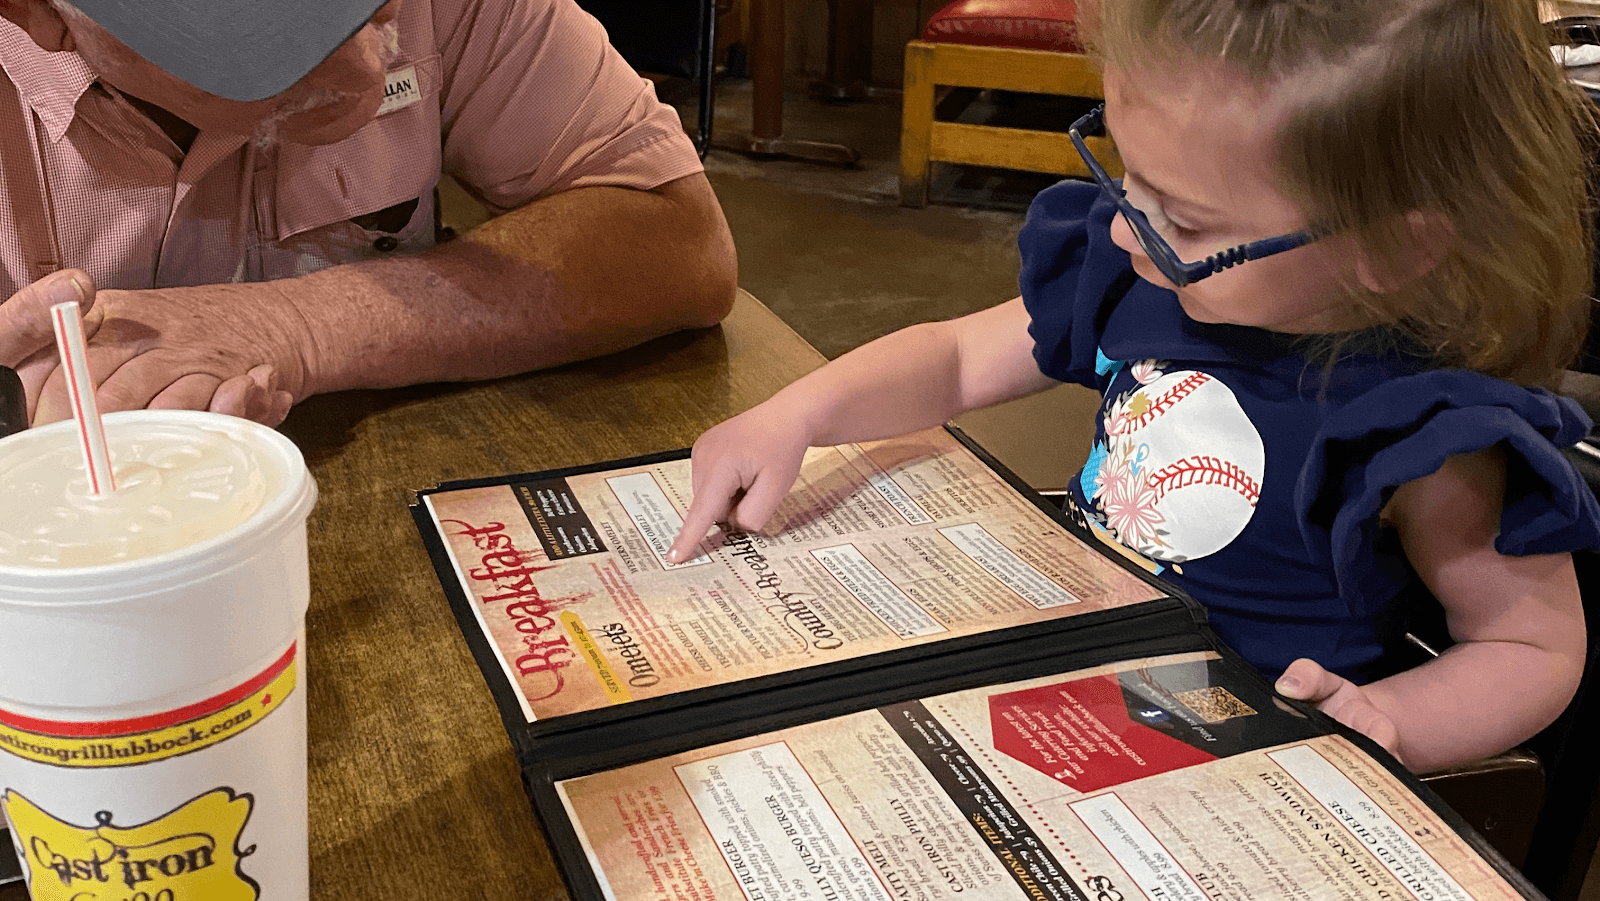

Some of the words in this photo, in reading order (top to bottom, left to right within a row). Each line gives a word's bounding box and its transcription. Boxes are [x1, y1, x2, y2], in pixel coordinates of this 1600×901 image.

[848, 493, 870, 510] STACK
[877, 485, 899, 501] TOAST
[864, 510, 887, 527] SHORT
[893, 501, 920, 522] FRENCH
[914, 495, 944, 518] OATMEAL
[600, 521, 621, 544] OMELET
[634, 513, 655, 536] OMELET
[615, 544, 639, 572] WESTERN
[820, 556, 840, 570] EGGS
[972, 554, 1015, 582] BREAKFAST
[840, 575, 863, 591] STEAK
[907, 588, 928, 602] EGGS
[1010, 583, 1029, 593] EGG
[441, 514, 582, 701] Breakfast
[858, 592, 881, 608] FRIED
[1024, 593, 1046, 606] TWO
[874, 607, 906, 631] CHICKEN
[929, 607, 953, 623] STEAK
[592, 621, 662, 689] Omelets
[1002, 711, 1014, 720] on
[1011, 704, 1041, 731] Services
[1031, 710, 1056, 728] Truck
[1008, 720, 1032, 739] latest
[1049, 728, 1074, 746] Food
[1086, 729, 1103, 741] our
[1190, 725, 1217, 741] Find
[886, 743, 902, 754] roll
[1029, 739, 1044, 750] the
[1037, 730, 1071, 760] Catering
[1040, 750, 1057, 763] For
[1068, 746, 1089, 760] and
[1097, 741, 1119, 756] visit
[706, 764, 722, 780] BBQ
[775, 765, 802, 792] peppers
[872, 760, 889, 773] bell
[945, 763, 968, 785] Cheese
[1067, 760, 1085, 773] our
[762, 770, 783, 790] sliced
[882, 773, 911, 797] grilled
[895, 772, 922, 797] topped
[922, 785, 934, 794] on
[962, 765, 997, 802] Mushrooms
[1229, 778, 1256, 802] lettuce
[1352, 770, 1377, 788] Grill
[700, 778, 723, 805] smoked
[723, 788, 746, 812] pickles
[790, 793, 808, 808] bell
[1187, 789, 1213, 814] crispy
[1258, 772, 1322, 830] SANDWICH
[1288, 787, 1312, 807] onion
[1376, 789, 1397, 805] Iron
[763, 794, 797, 836] BURGER
[852, 805, 878, 830] melted
[885, 796, 922, 834] PHILLY
[927, 796, 954, 820] served
[991, 803, 1018, 827] Grilled
[1307, 808, 1325, 820] red
[1395, 807, 1421, 826] Cast
[740, 813, 760, 842] onions,
[787, 809, 812, 835] topped
[807, 808, 840, 855] mushrooms,
[915, 816, 938, 837] steak
[919, 799, 957, 842] mushrooms
[969, 811, 1003, 845] ITEMS:
[981, 806, 1014, 841] Jalapeños
[1100, 809, 1125, 833] chicken
[1150, 801, 1192, 843] guacamole,
[1208, 815, 1233, 835] thick
[1258, 803, 1308, 853] mayonnaise,
[1327, 800, 1378, 844] CHEESE
[1371, 826, 1385, 837] an
[727, 825, 751, 852] topped
[890, 833, 908, 852] 8.29
[951, 822, 975, 846] cheese
[1331, 828, 1362, 856] tomato
[1383, 825, 1419, 854] pickles
[790, 837, 822, 874] QUESO
[807, 835, 831, 858] patty
[862, 838, 890, 868] MELT
[880, 840, 904, 866] onions
[914, 835, 943, 862] IRON
[934, 837, 957, 862] Philly
[1189, 844, 1215, 871] cheese,
[1383, 838, 1423, 874] between
[31, 832, 117, 884] Cast
[119, 846, 215, 889] iron
[721, 839, 755, 884] BURGER
[746, 852, 769, 875] patty
[753, 843, 791, 893] caramelized
[838, 855, 862, 883] queso,
[966, 854, 990, 885] onions,
[972, 848, 994, 871] Swiss
[1032, 848, 1058, 876] Onions
[1136, 849, 1161, 872] apples
[1239, 844, 1271, 875] tomato
[1310, 855, 1340, 885] cheese,
[1319, 832, 1379, 886] CHICKEN
[935, 863, 965, 892] CAST
[949, 862, 978, 889] Sliced
[987, 870, 1003, 881] of
[1028, 862, 1049, 883] Chile
[1210, 873, 1235, 890] jack
[1364, 857, 1393, 886] lettuce,
[1374, 846, 1436, 901] GRILLED
[926, 883, 942, 898] rye
[1420, 875, 1451, 897] pork
